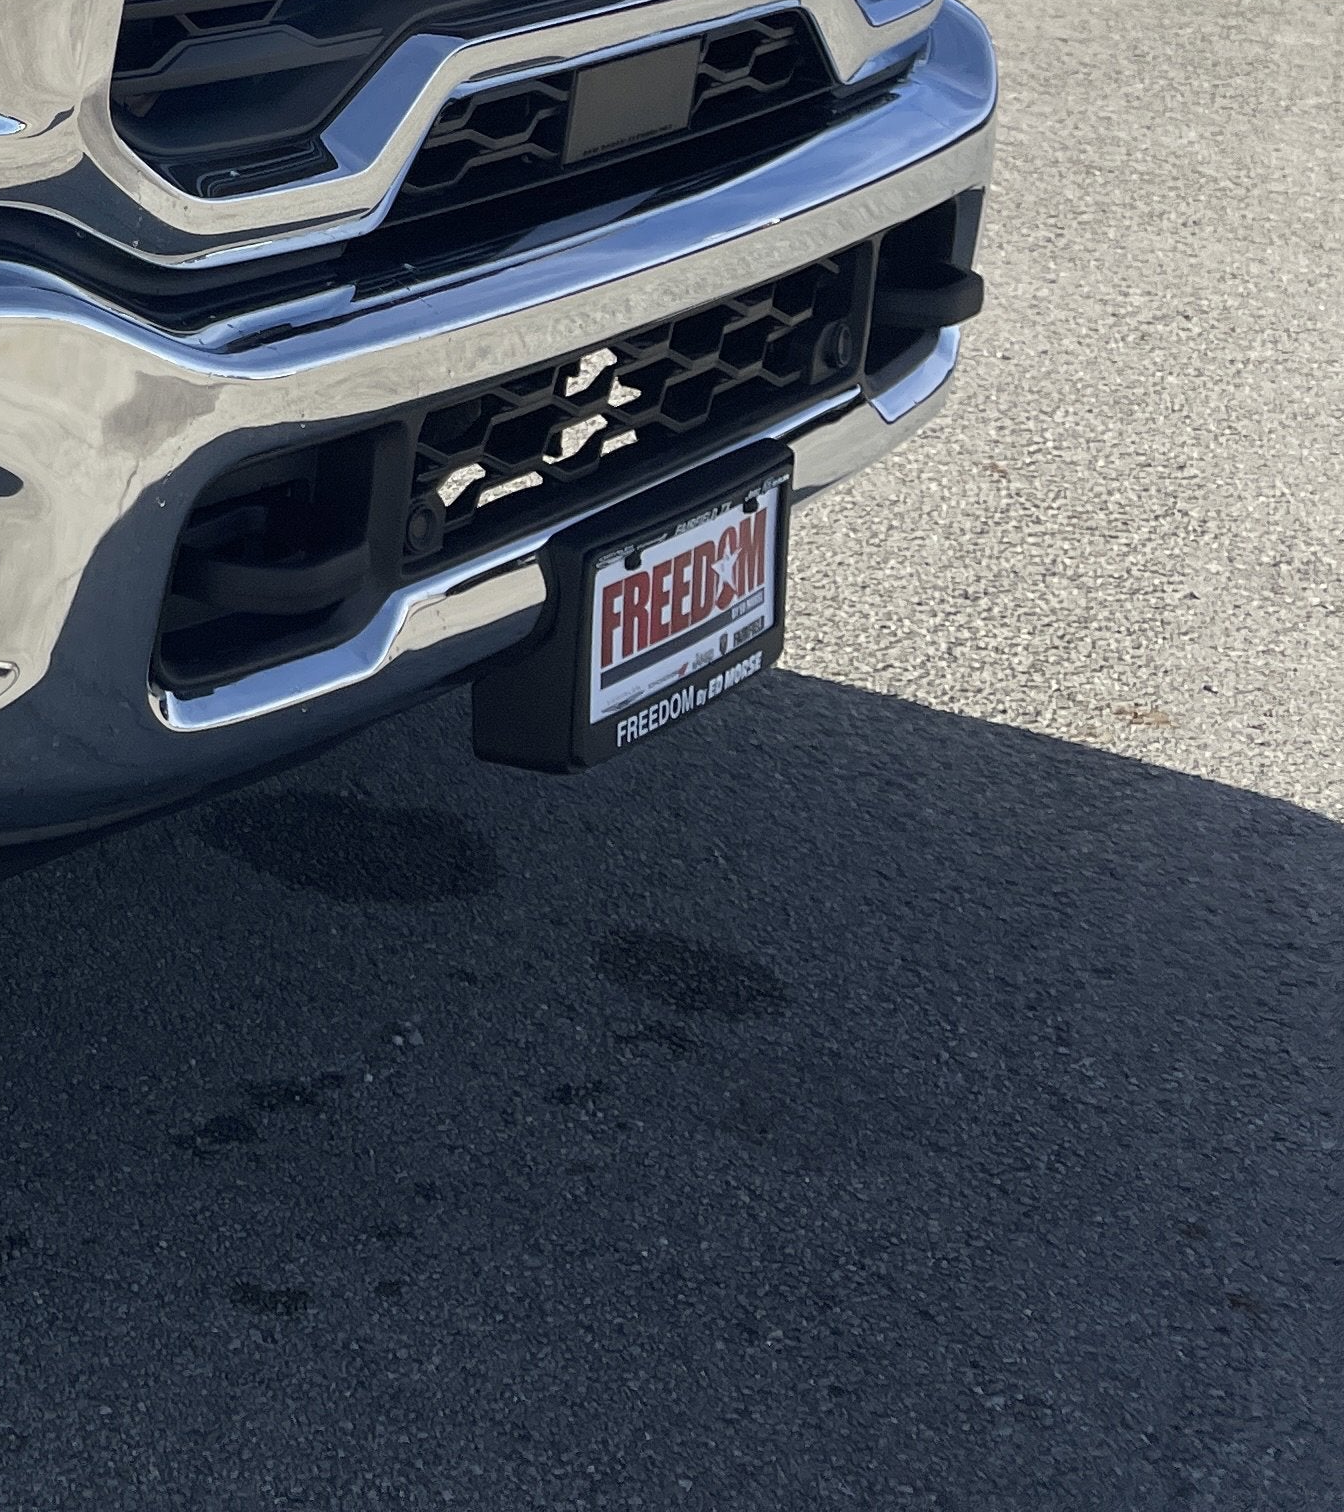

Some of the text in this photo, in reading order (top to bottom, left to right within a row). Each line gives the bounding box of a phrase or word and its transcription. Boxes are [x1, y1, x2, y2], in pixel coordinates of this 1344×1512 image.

[600, 506, 768, 670] FREEDOM
[616, 685, 695, 748] FREEDOM
[708, 675, 723, 700] ED
[724, 650, 763, 690] MORSE
